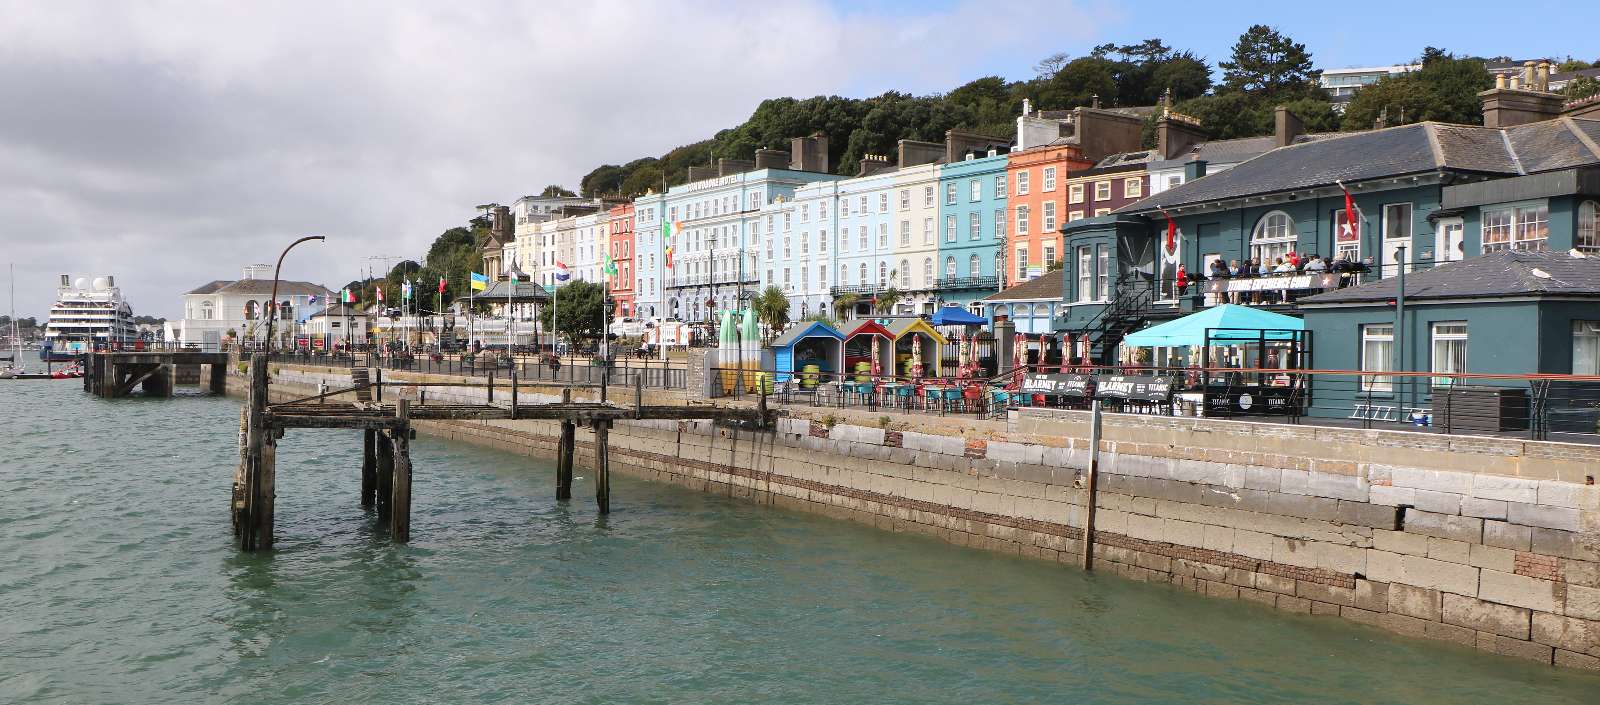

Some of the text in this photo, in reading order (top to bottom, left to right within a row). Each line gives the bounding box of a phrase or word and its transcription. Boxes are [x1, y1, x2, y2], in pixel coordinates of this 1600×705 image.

[1227, 279, 1252, 292] TITANIC
[1252, 277, 1291, 291] EXPERIENCE
[1024, 378, 1057, 391] BLARNEY
[1067, 380, 1086, 389] TITANIC
[1098, 382, 1134, 393] BLARNEY
[1148, 383, 1169, 392] TITANIC
